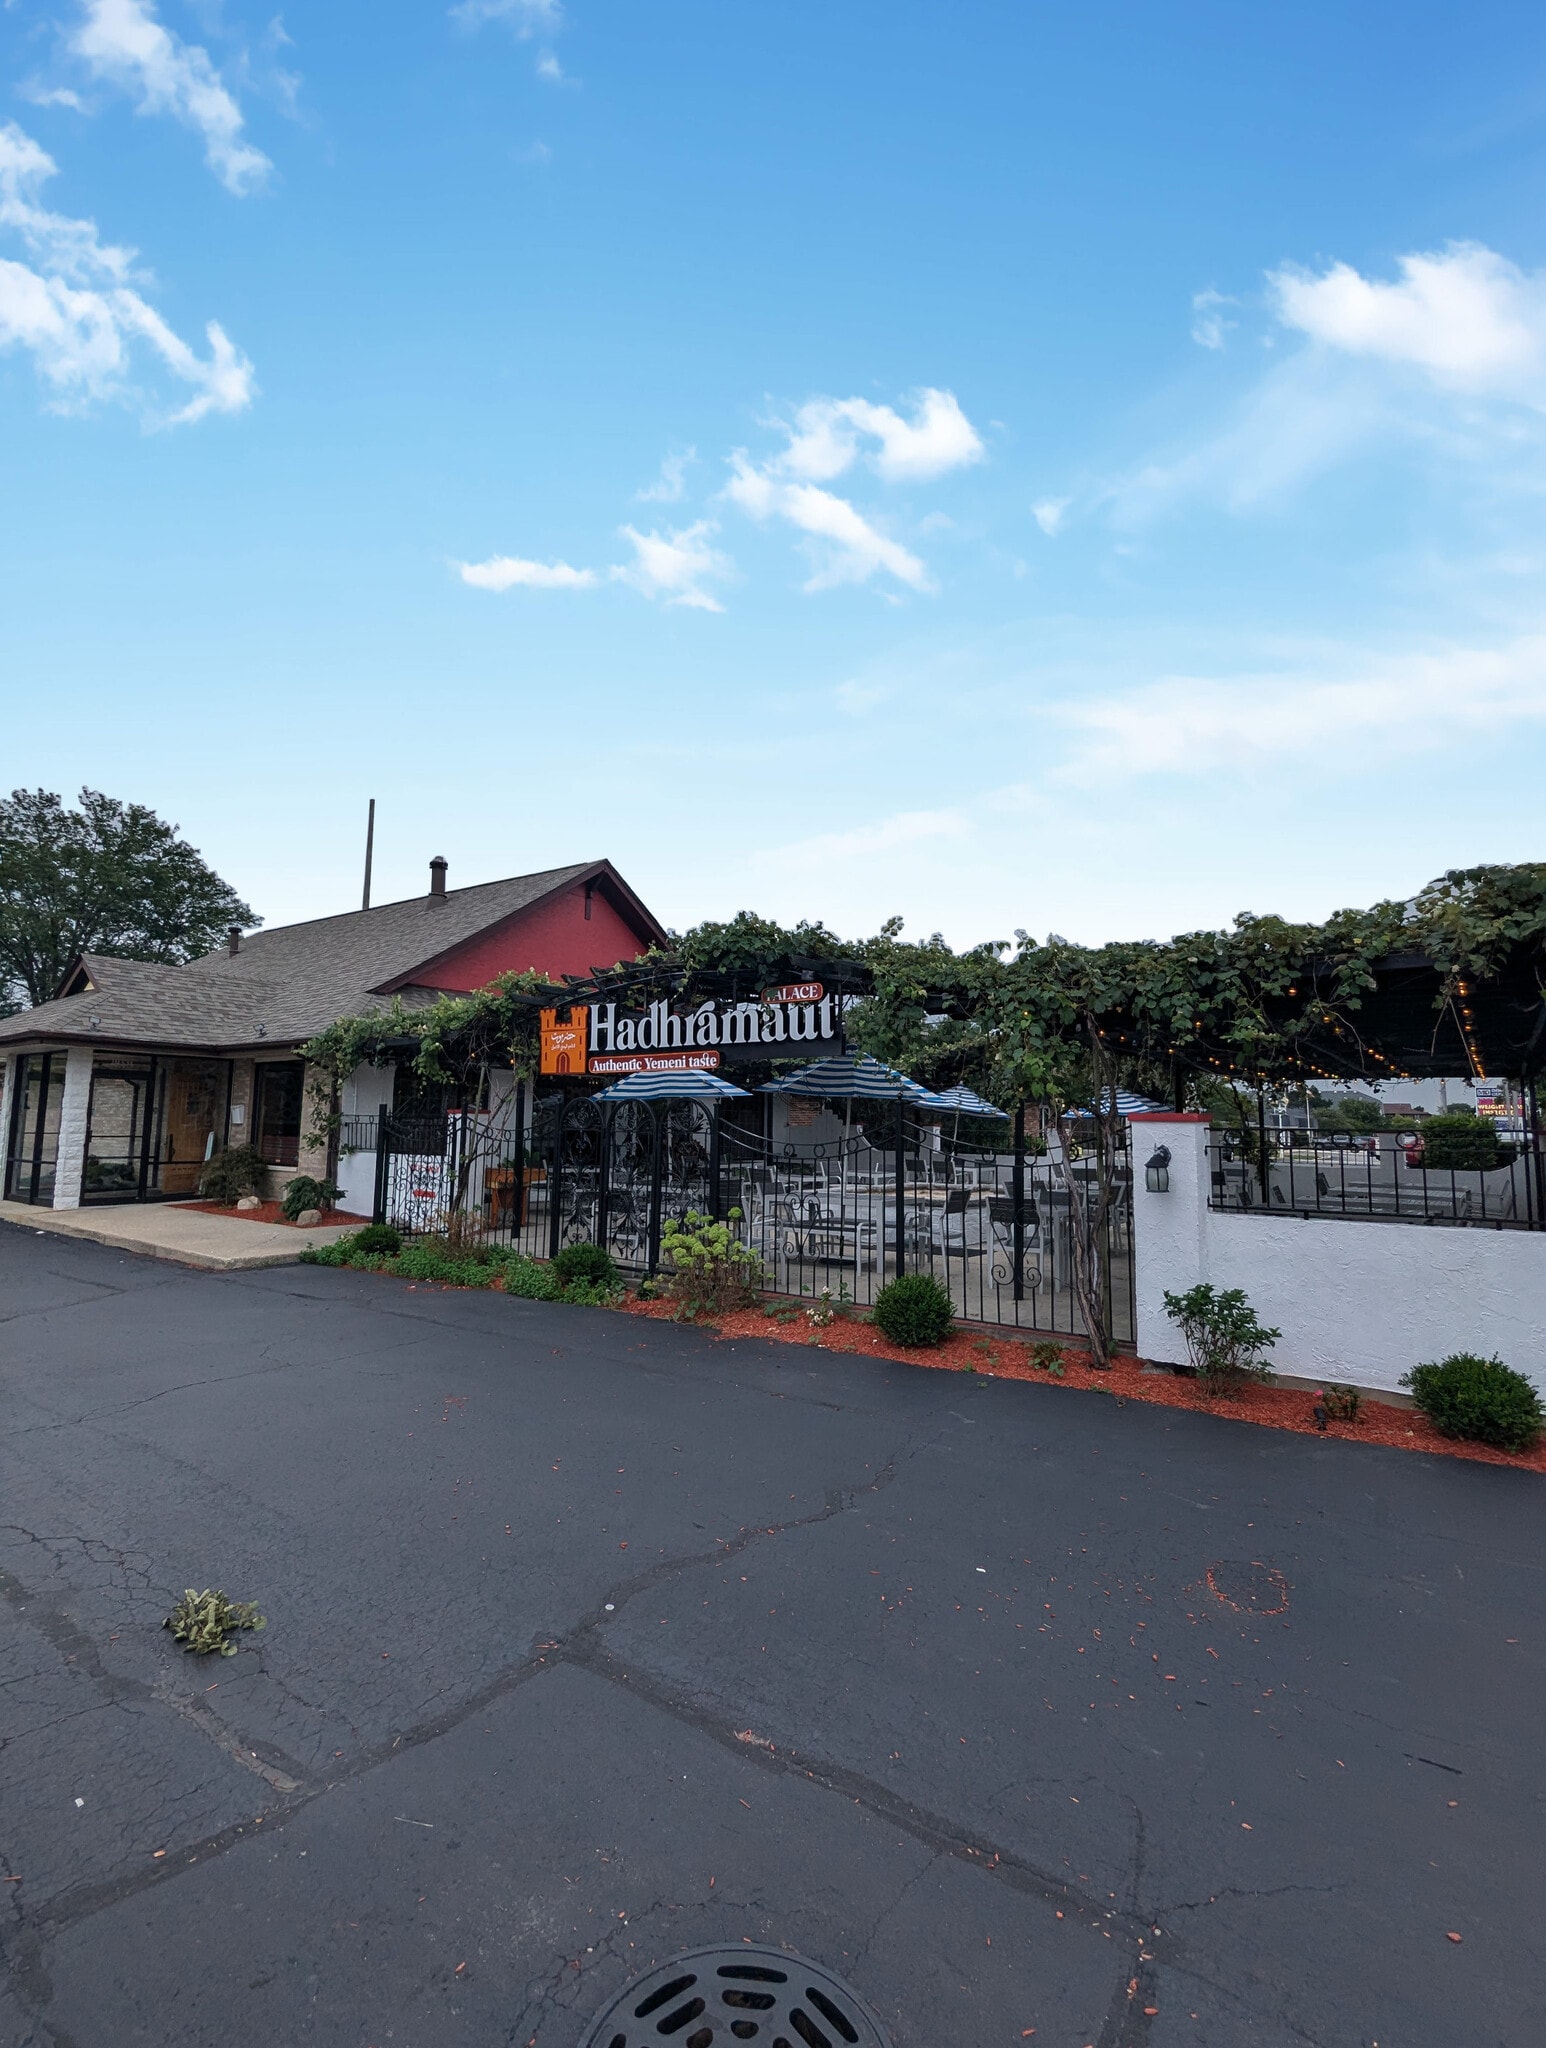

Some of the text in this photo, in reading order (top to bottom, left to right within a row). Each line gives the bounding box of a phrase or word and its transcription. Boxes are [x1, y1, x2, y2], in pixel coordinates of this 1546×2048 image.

[589, 992, 835, 1051] Hadhramaut
[592, 1053, 717, 1072] Authentic Yemeni taste
